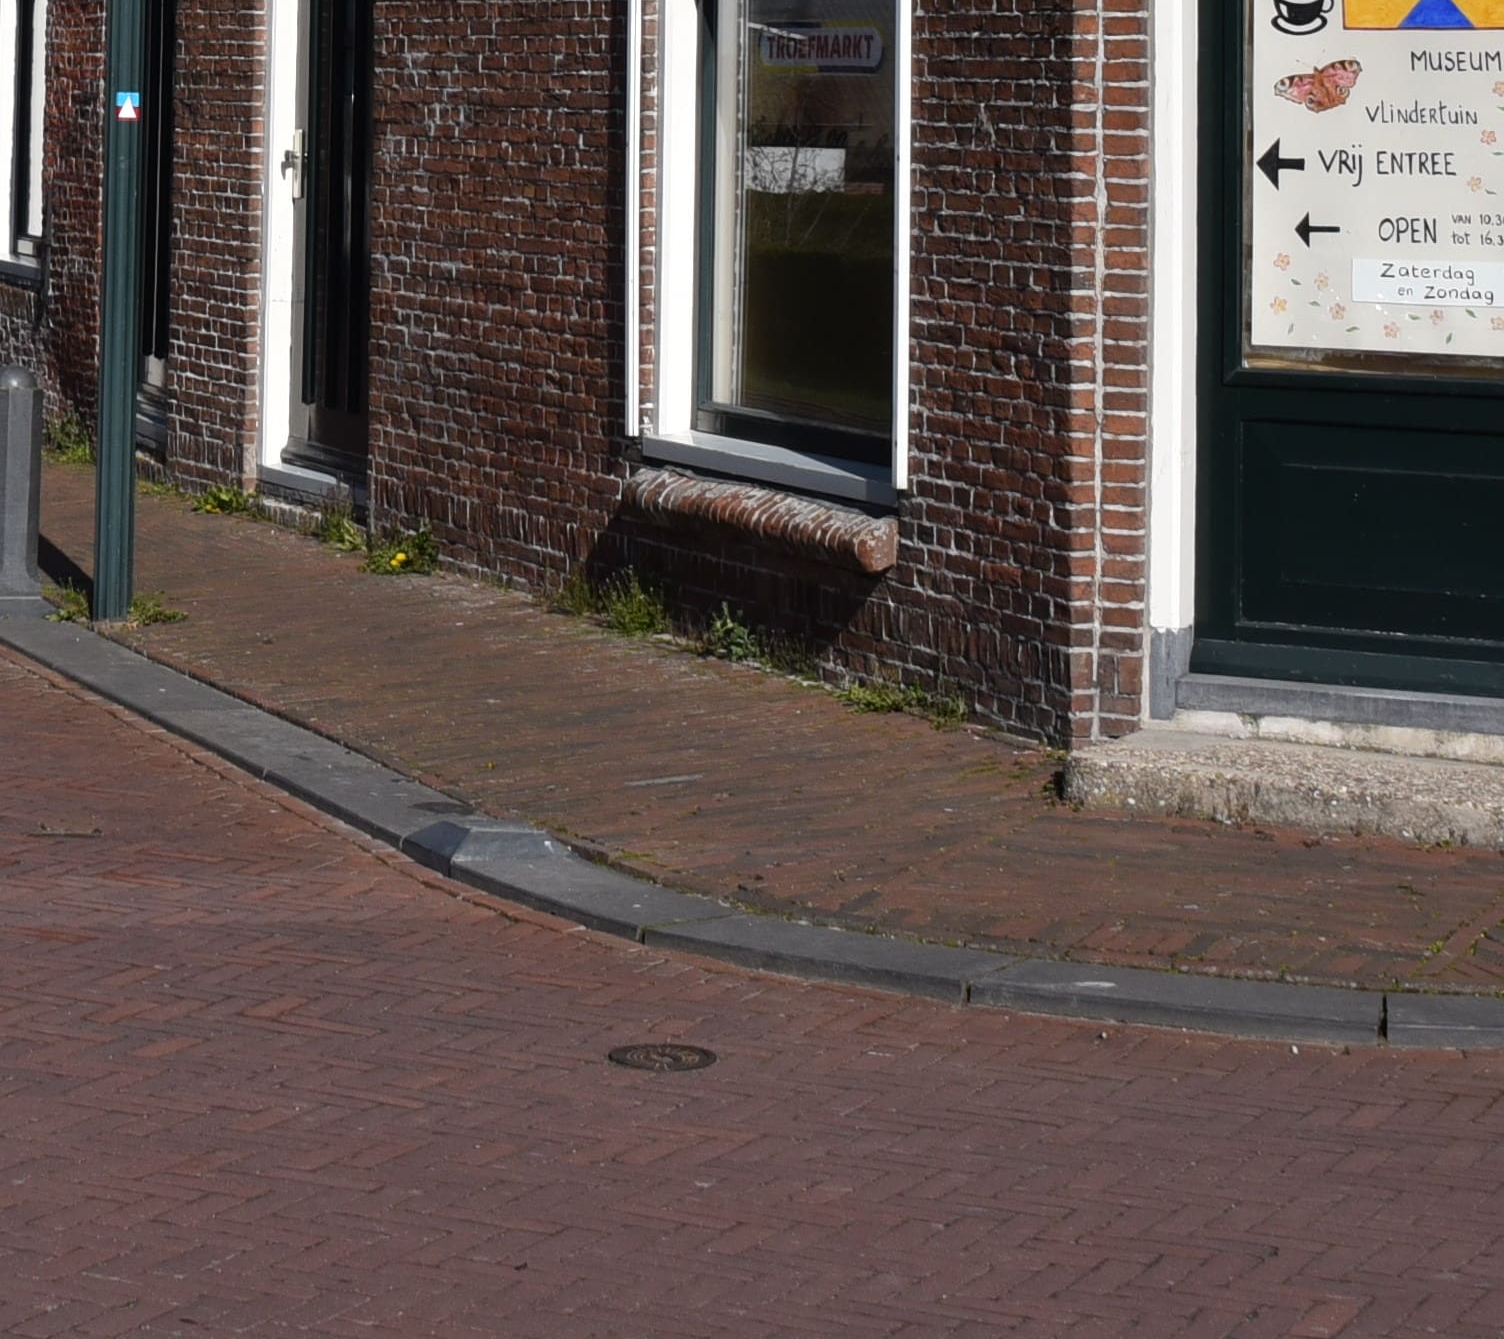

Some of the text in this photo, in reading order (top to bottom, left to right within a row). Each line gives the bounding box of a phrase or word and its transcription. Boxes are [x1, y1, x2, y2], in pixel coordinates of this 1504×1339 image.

[1410, 50, 1503, 72] MUSEUM
[1376, 150, 1457, 176] ENTREE
[1378, 217, 1437, 244] OPEN
[1452, 231, 1470, 245] tot
[1380, 262, 1475, 286] Zaterdag
[1397, 285, 1494, 305] en Zondag
